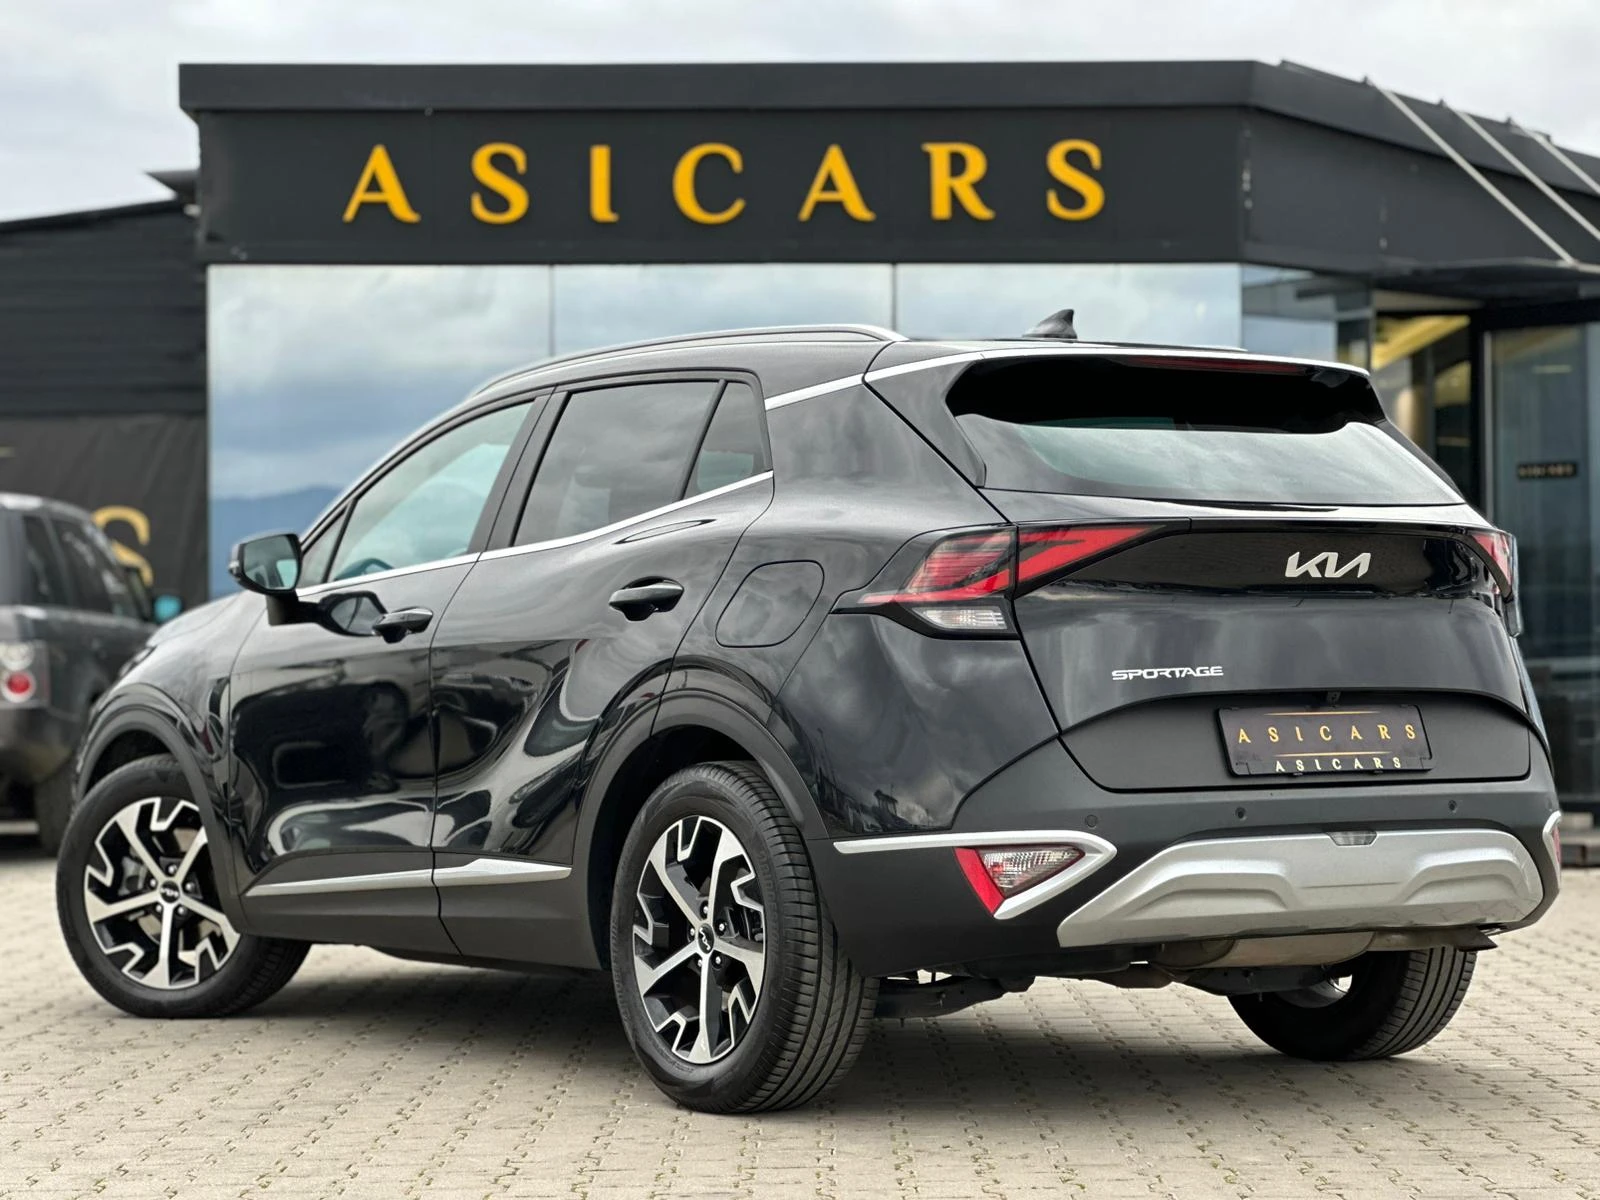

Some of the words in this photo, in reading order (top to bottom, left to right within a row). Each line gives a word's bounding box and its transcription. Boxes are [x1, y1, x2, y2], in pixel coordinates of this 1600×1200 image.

[342, 139, 1106, 224] ASICARS
[1285, 551, 1371, 578] KIA
[1111, 666, 1224, 680] SPORTAGE
[1238, 724, 1416, 743] ASICARS
[1275, 756, 1401, 772] ASICARS
